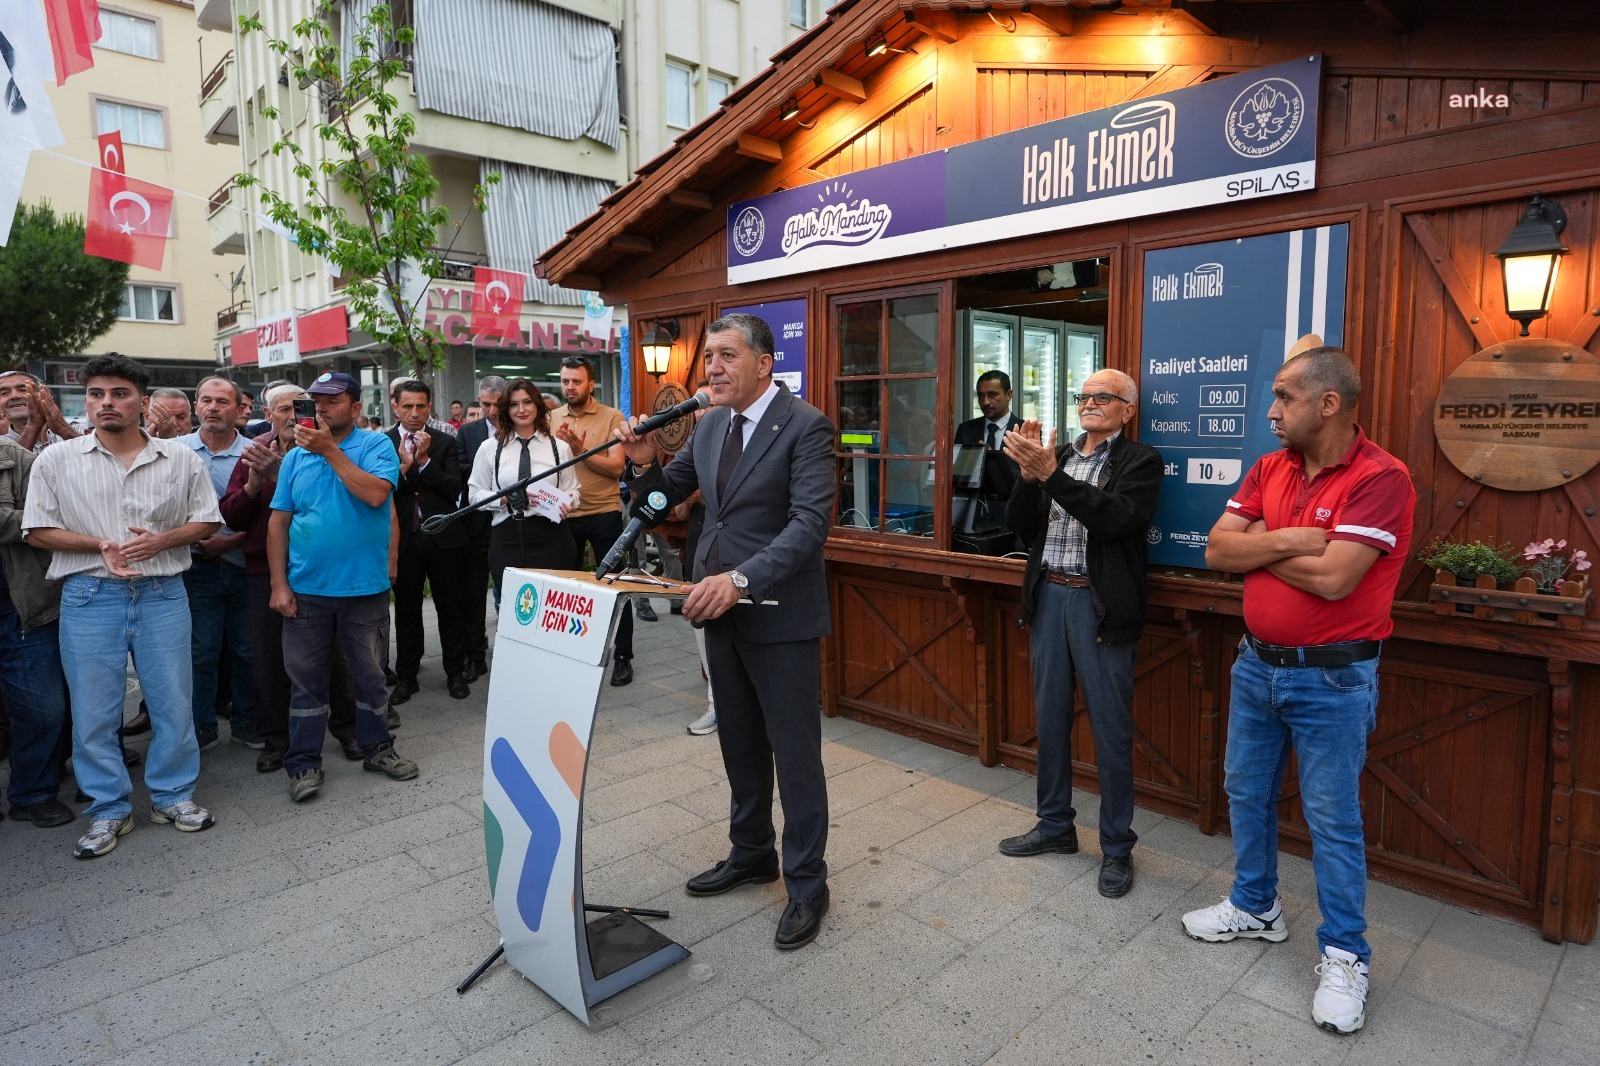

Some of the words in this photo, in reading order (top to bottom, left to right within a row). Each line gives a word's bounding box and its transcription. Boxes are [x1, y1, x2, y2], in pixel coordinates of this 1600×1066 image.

[1022, 137, 1076, 205] Halk
[1086, 100, 1176, 193] Ekmek
[784, 216, 819, 248] Halk
[1152, 273, 1179, 302] Halk
[1183, 262, 1224, 299] Ekmek
[257, 317, 293, 348] ECZANE
[1149, 357, 1197, 376] Faaliyet
[1198, 354, 1248, 373] Saatleri
[1152, 390, 1179, 405] Açılış:
[1208, 390, 1240, 404] 09.00
[1151, 418, 1191, 434] Kapanış:
[1208, 418, 1236, 432] 18.00
[1199, 463, 1213, 480] 10
